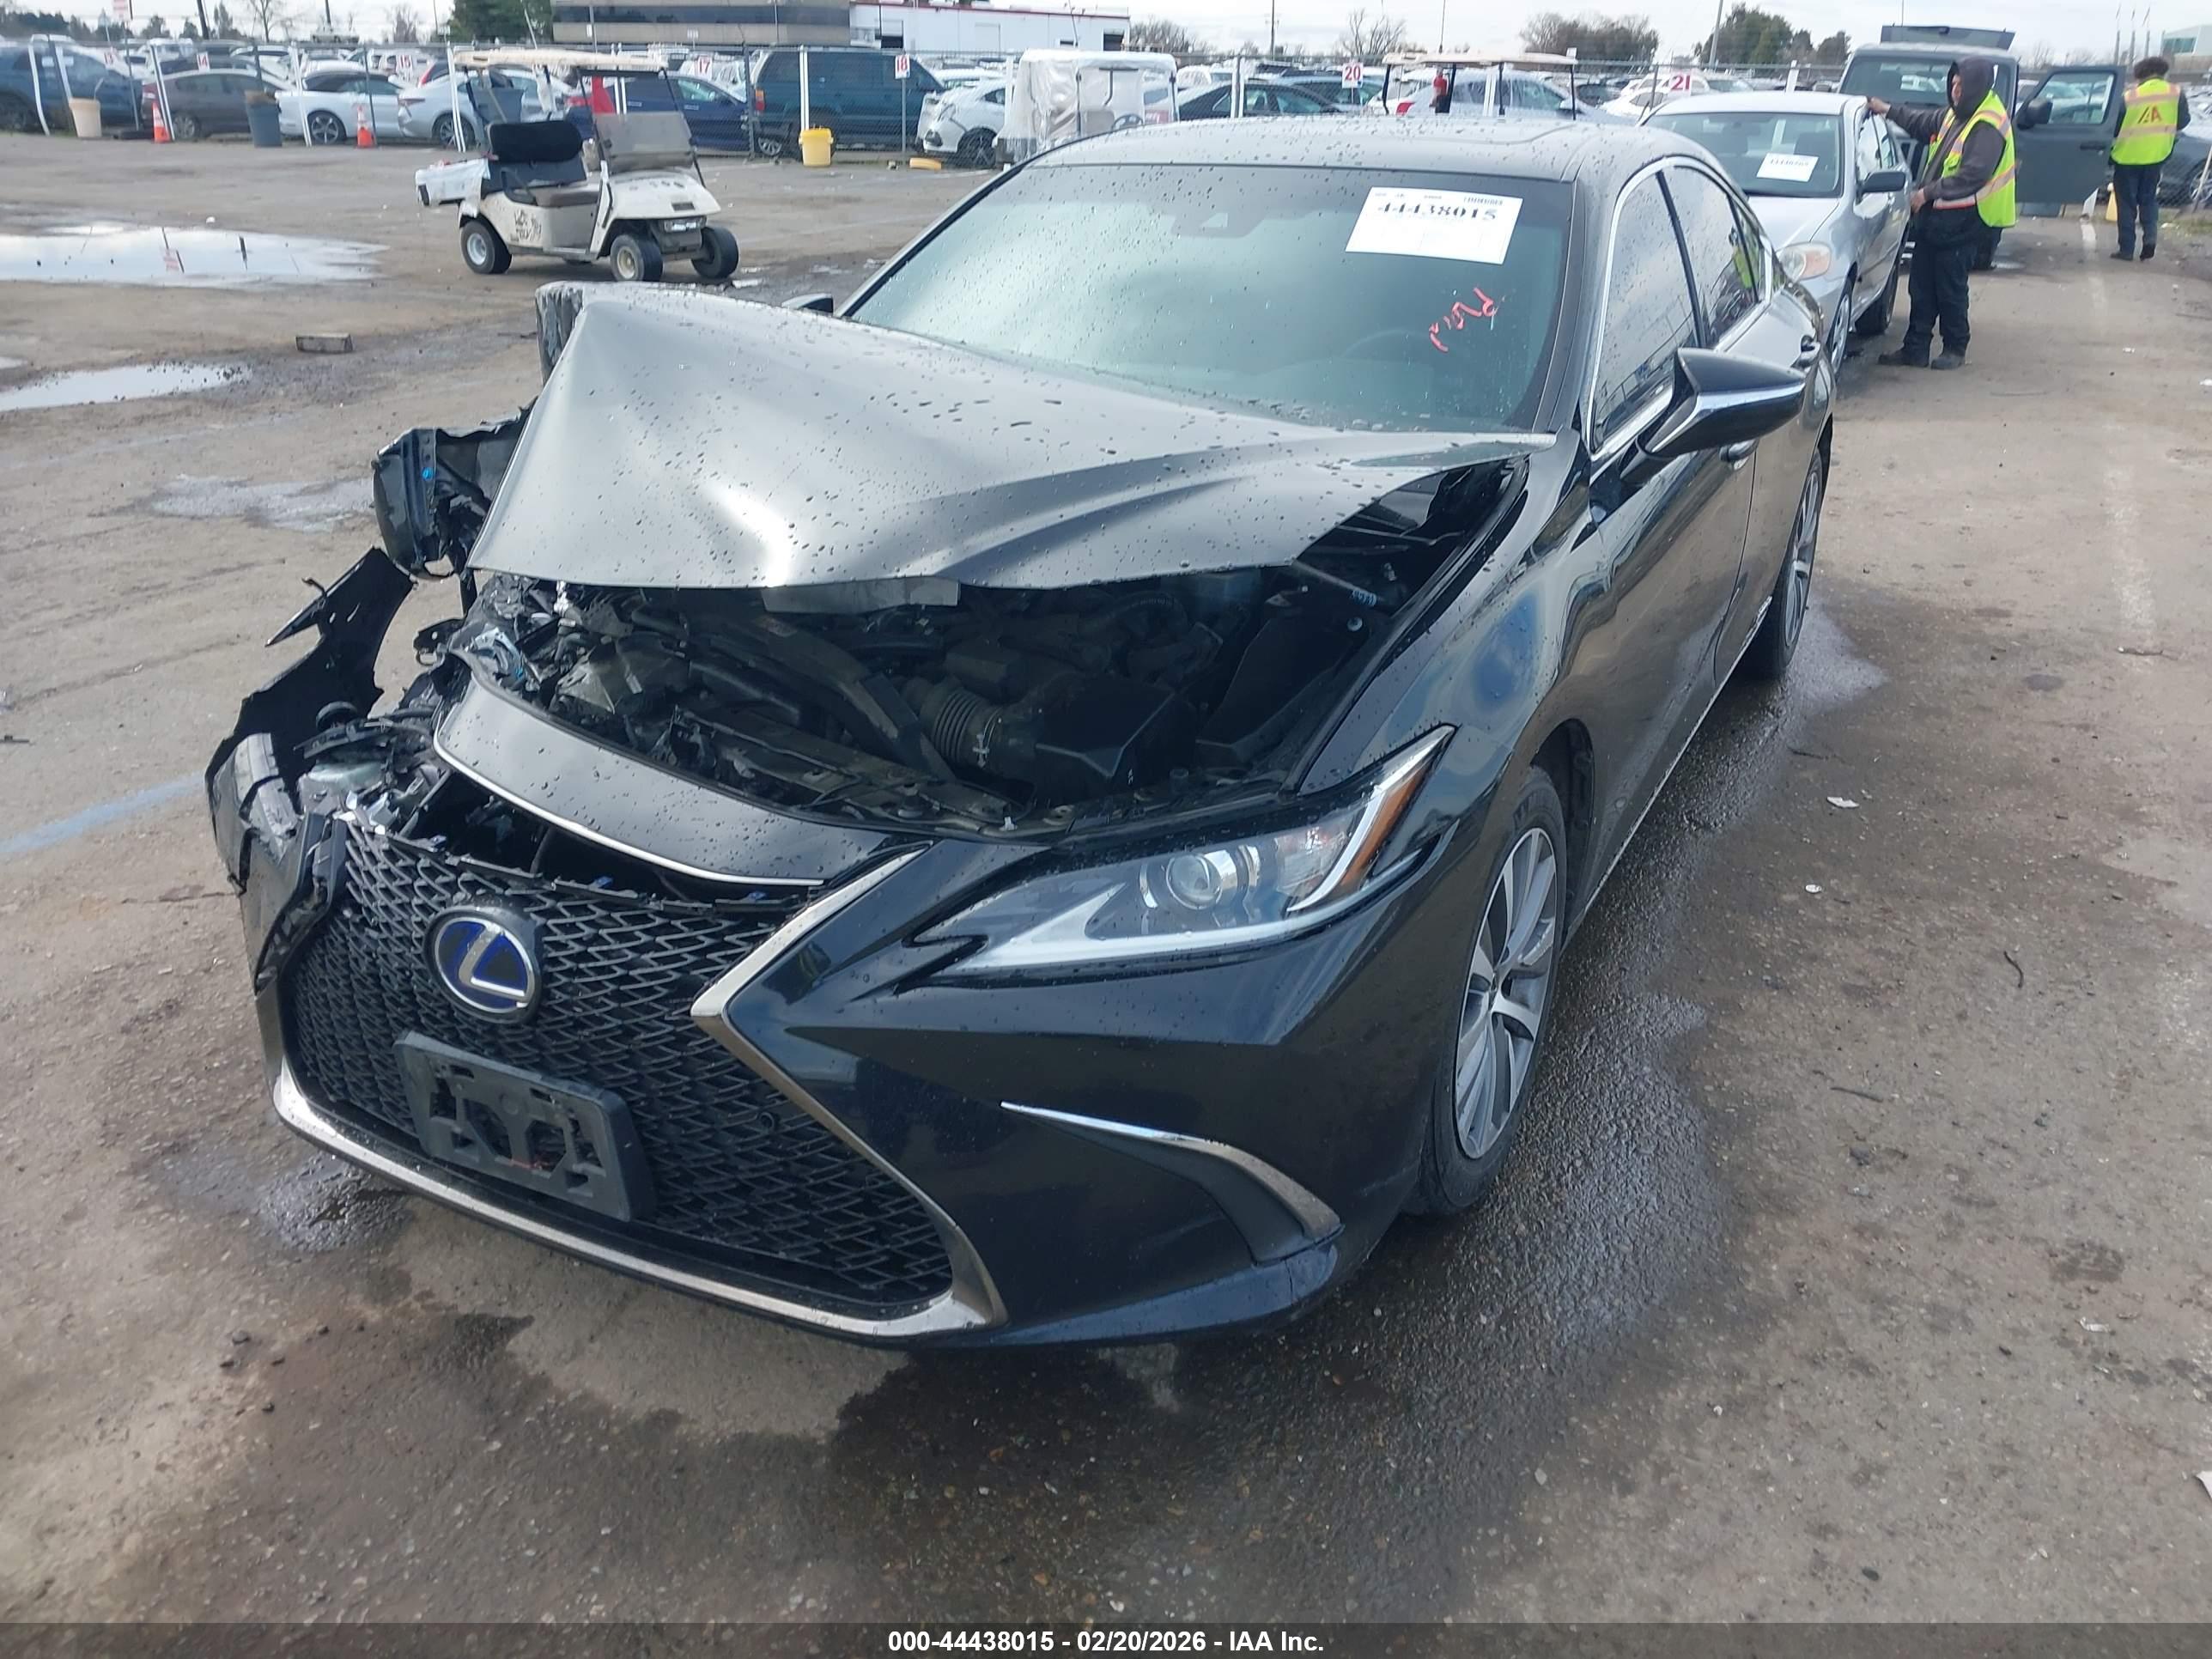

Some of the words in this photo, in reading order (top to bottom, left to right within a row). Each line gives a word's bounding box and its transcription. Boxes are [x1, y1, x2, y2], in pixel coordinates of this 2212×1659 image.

[699, 56, 710, 73] 17
[897, 56, 908, 71] 18
[1345, 65, 1360, 81] 20
[1671, 75, 1690, 90] 21
